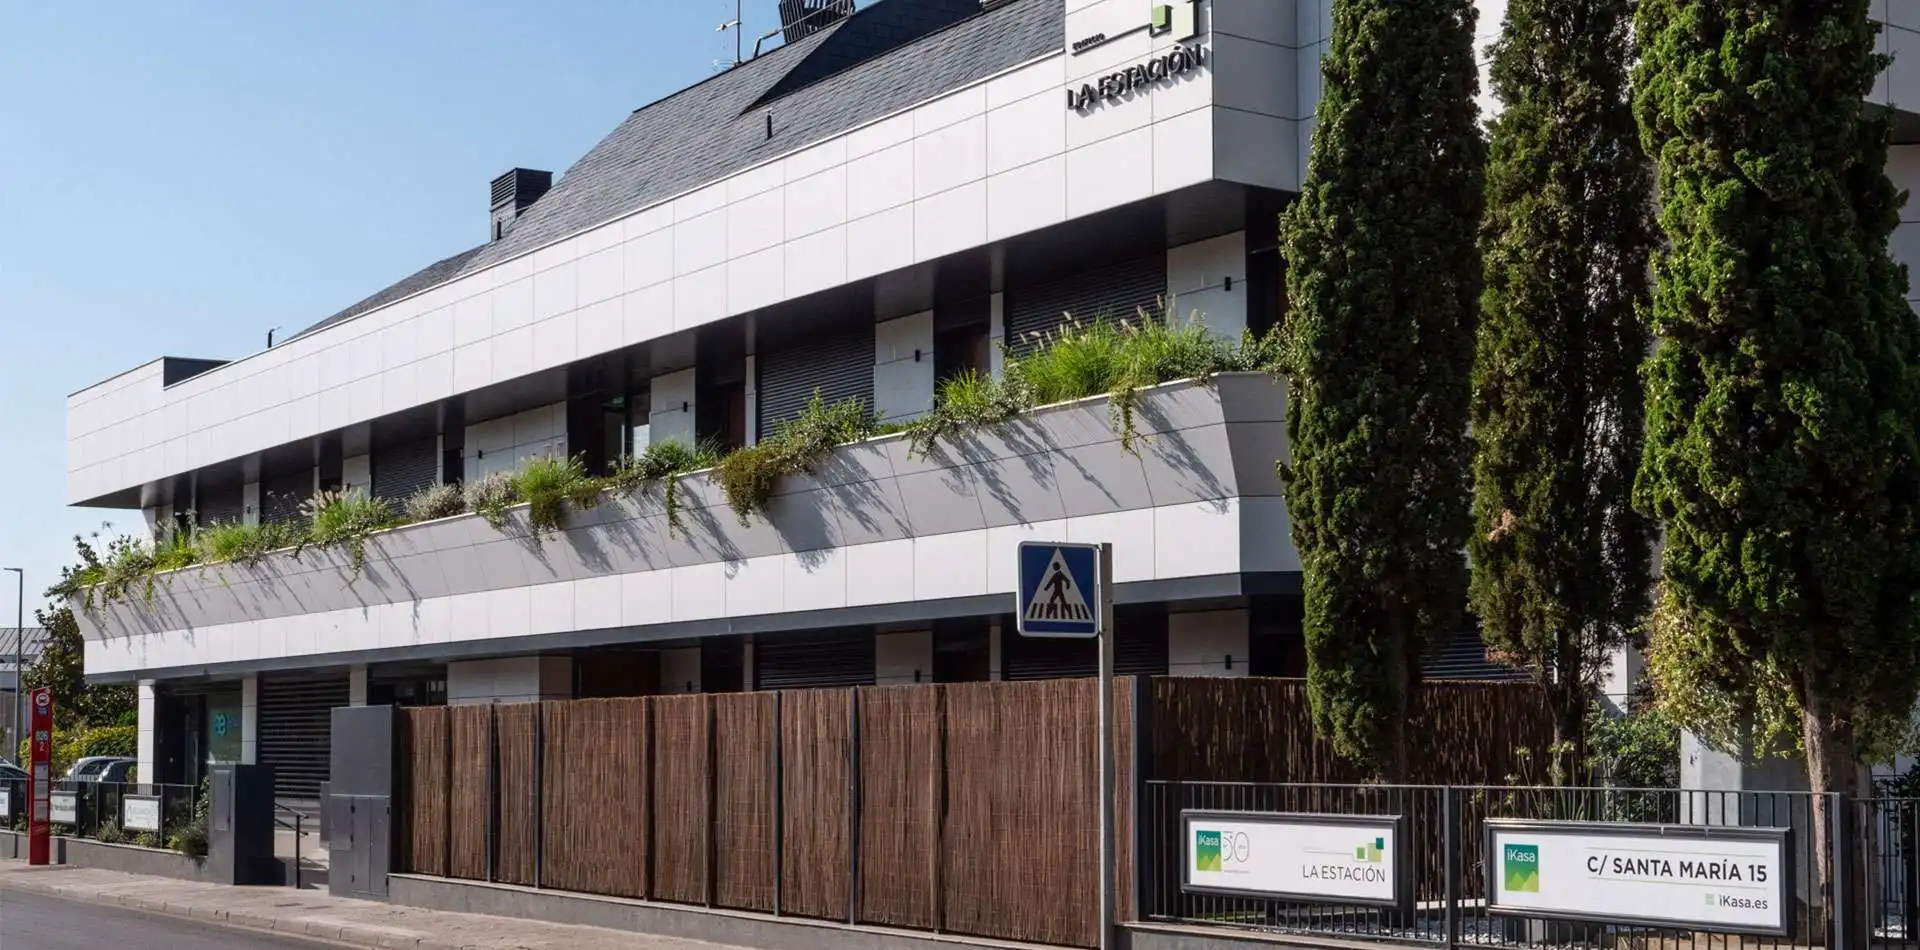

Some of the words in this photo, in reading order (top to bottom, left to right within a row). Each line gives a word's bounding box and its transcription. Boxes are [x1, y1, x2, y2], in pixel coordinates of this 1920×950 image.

[1067, 83, 1096, 111] LA
[1097, 43, 1204, 98] ESTACIÓN
[1199, 833, 1219, 846] iKasa
[1506, 848, 1536, 862] iKasa
[1302, 864, 1319, 879] LA
[1321, 864, 1386, 883] ESTACIÓN
[1586, 855, 1608, 875] C/
[1613, 857, 1673, 877] SANTA
[1680, 859, 1742, 881] MARÍA
[1748, 864, 1767, 882] 15
[1719, 894, 1768, 910] iKasa.es
